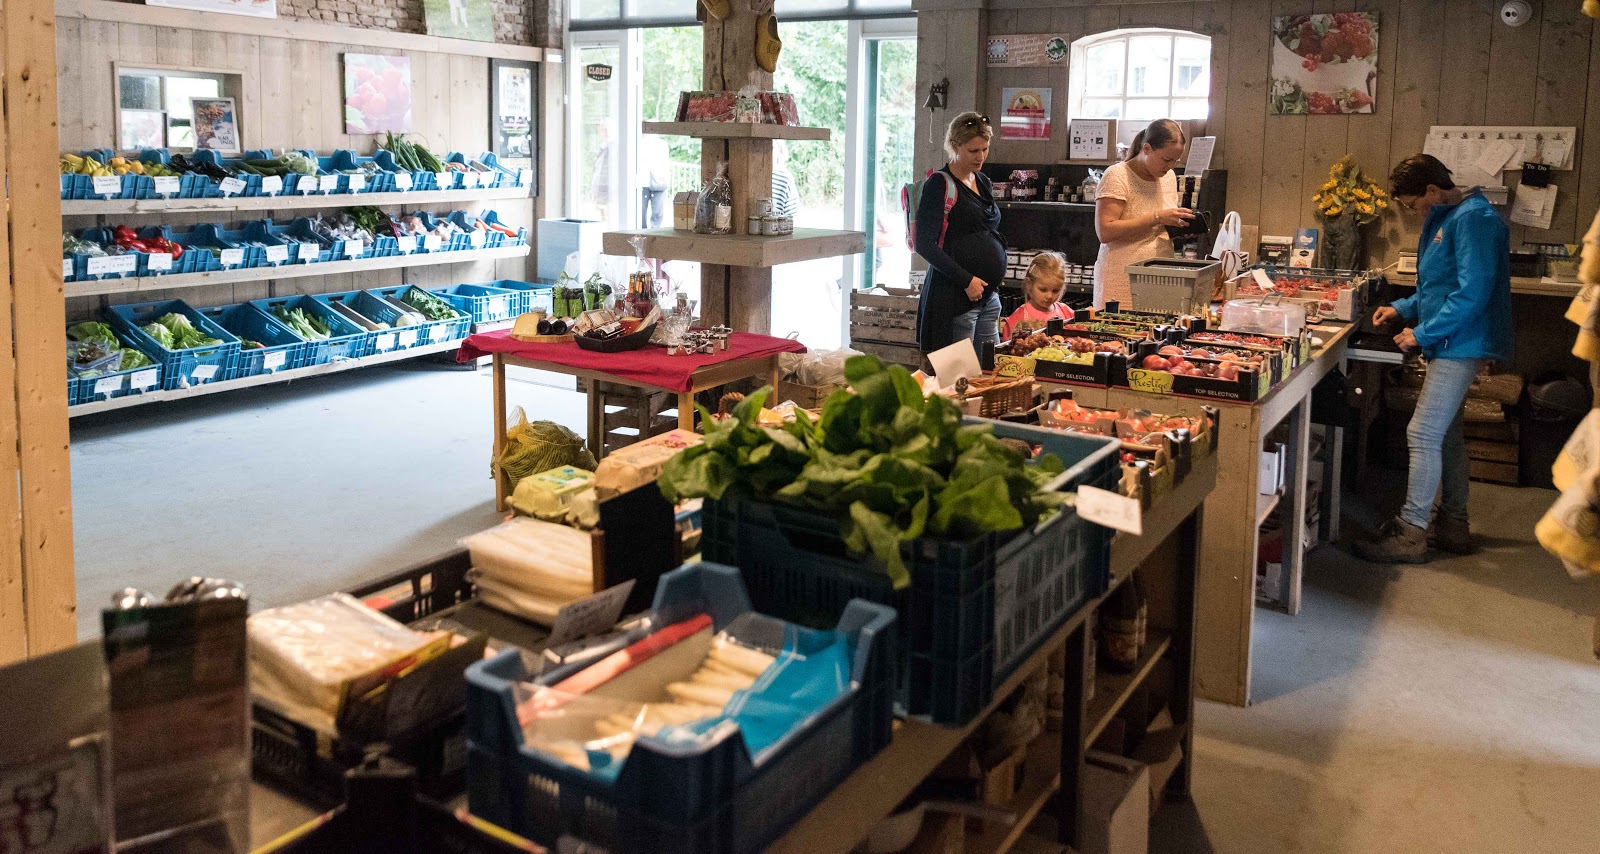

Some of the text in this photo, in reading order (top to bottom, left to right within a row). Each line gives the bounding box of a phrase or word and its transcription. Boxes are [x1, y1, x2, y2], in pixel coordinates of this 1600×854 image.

[588, 66, 610, 75] CLOSED
[1066, 373, 1095, 381] SELECTION
[1127, 370, 1173, 394] Prestige
[1207, 390, 1239, 398] SELECTION
